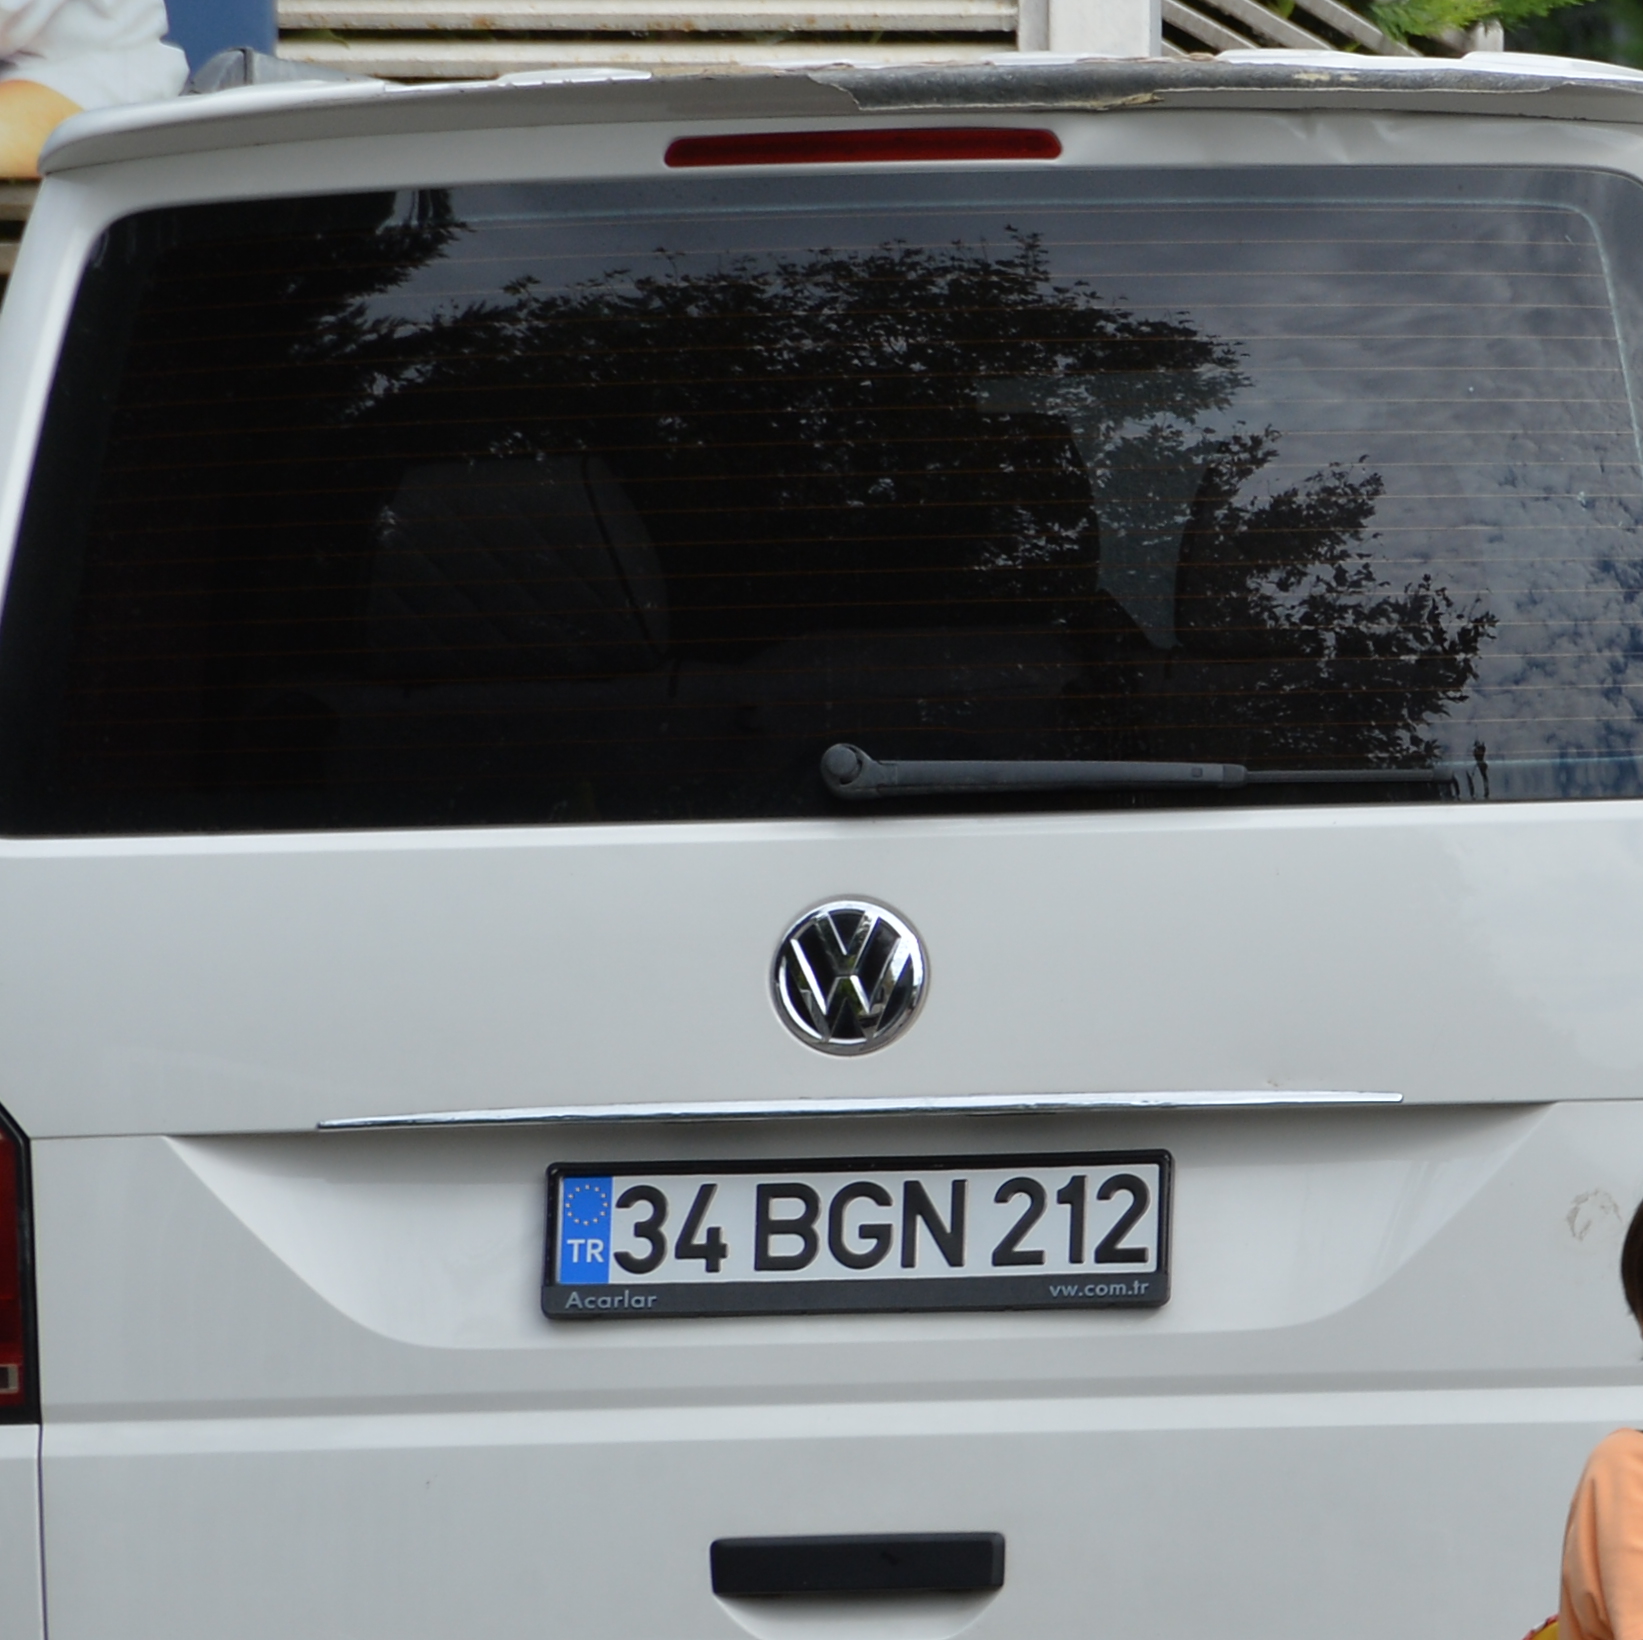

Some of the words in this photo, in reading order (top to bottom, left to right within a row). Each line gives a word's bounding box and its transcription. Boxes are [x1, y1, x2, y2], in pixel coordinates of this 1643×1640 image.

[774, 900, 923, 1050] VW
[613, 1182, 729, 1274] 34
[753, 1178, 968, 1272] BGN
[990, 1172, 1151, 1267] 212
[567, 1239, 605, 1264] TR
[565, 1289, 658, 1310] Acarlar
[1049, 1280, 1149, 1297] vw.com.tr
